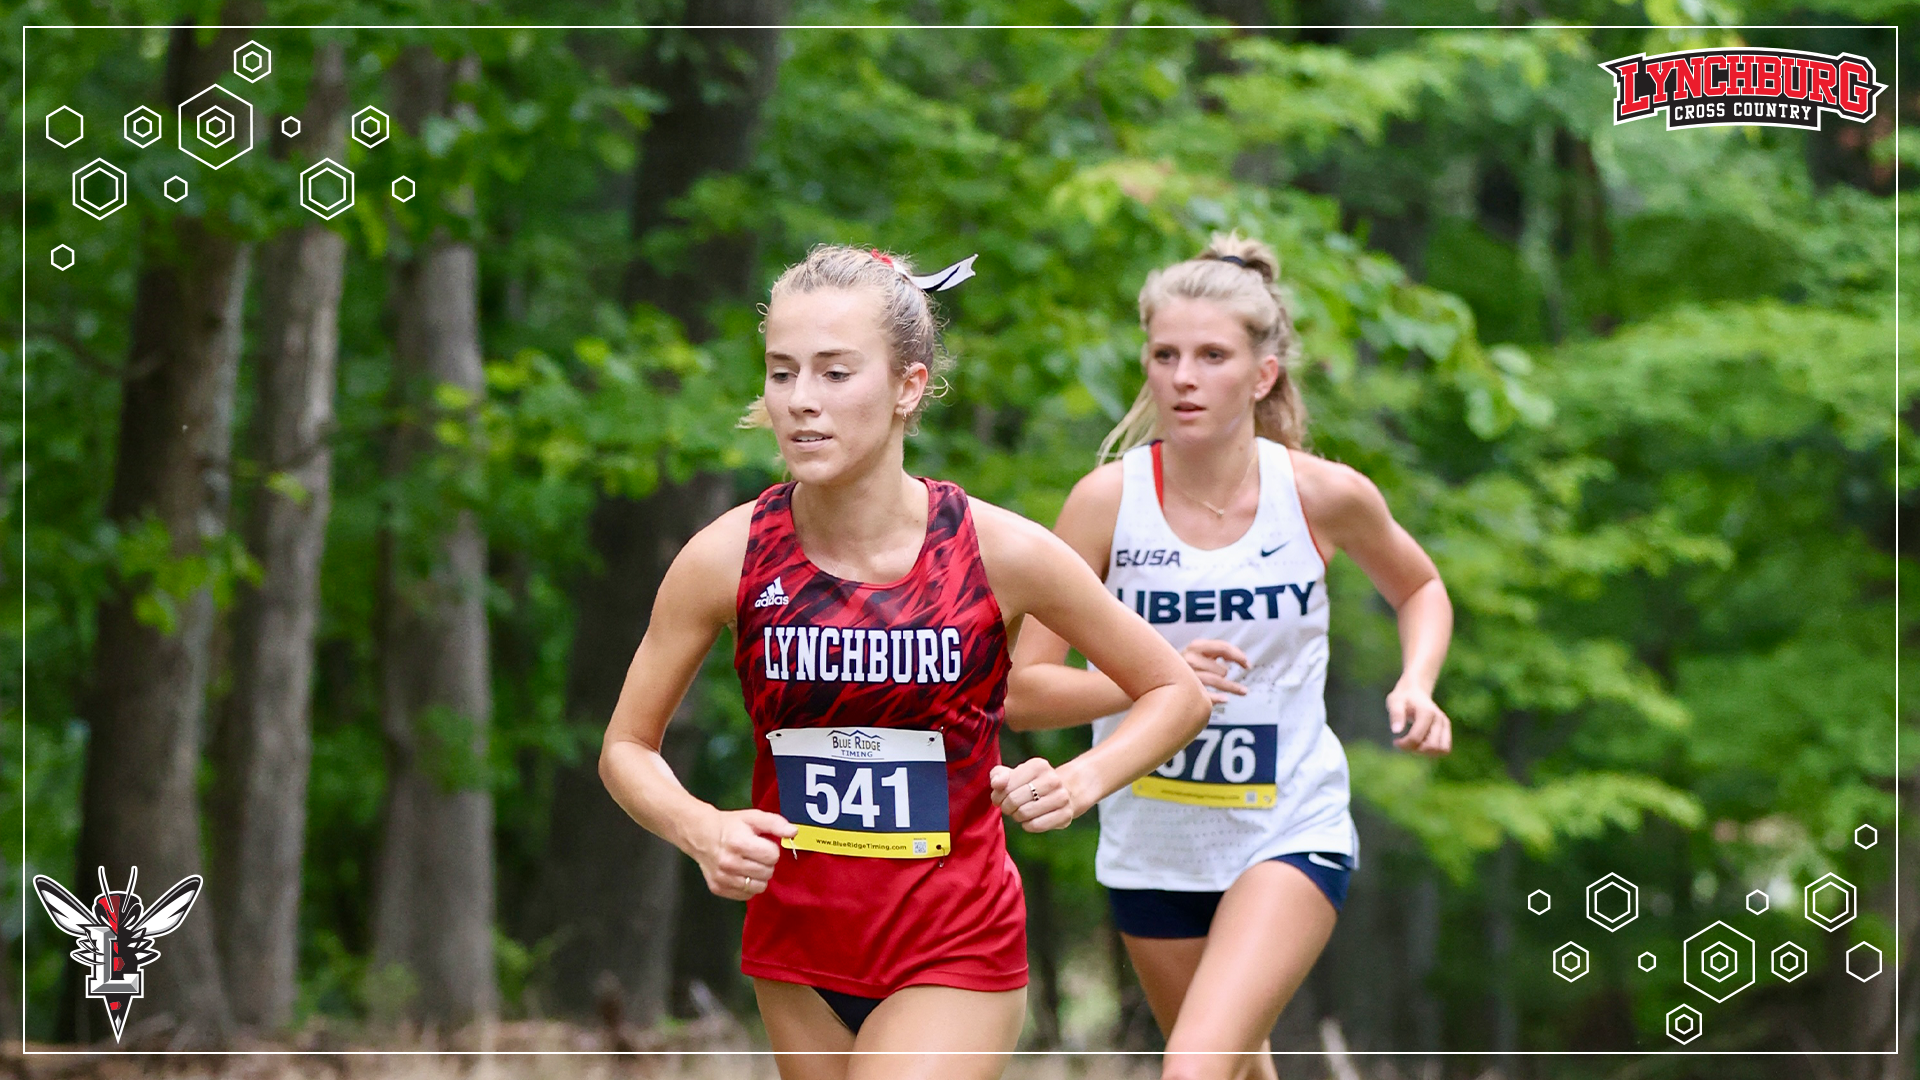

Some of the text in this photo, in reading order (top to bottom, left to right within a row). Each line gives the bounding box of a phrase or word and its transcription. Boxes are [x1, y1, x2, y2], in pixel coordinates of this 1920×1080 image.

[763, 626, 961, 684] LYNCHBURG
[841, 749, 873, 758] TIMING
[805, 763, 911, 828] 541
[816, 838, 907, 850] www.BlueRidgeTiming.com
